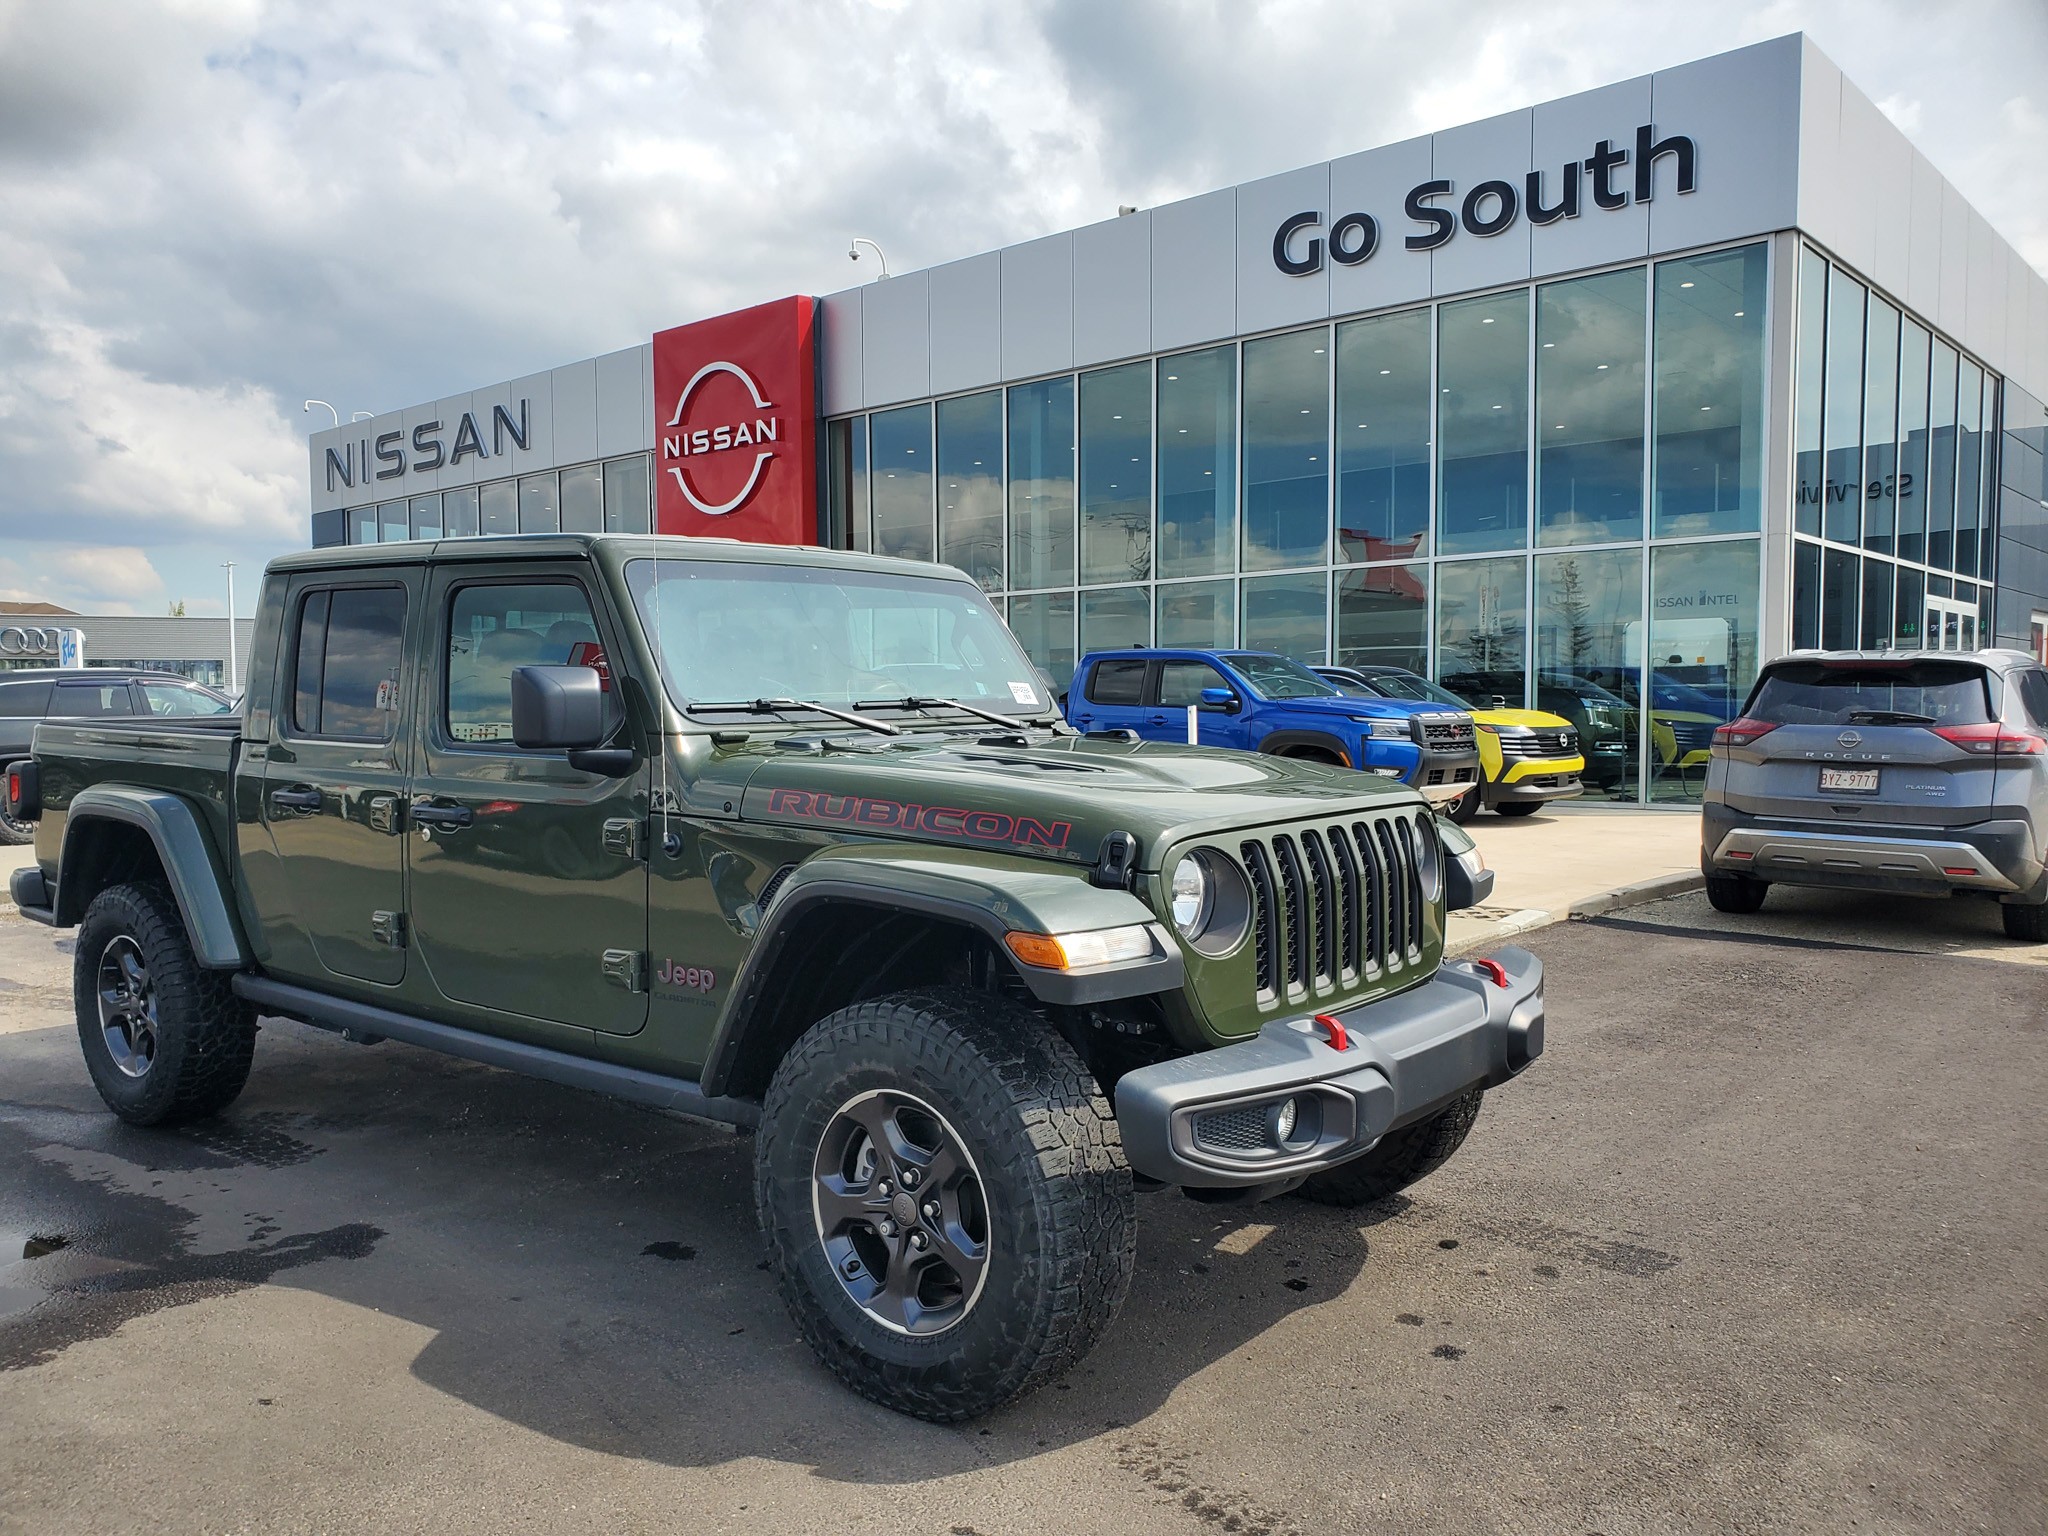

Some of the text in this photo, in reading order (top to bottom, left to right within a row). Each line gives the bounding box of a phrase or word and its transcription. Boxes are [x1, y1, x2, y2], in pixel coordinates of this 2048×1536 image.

[1272, 122, 1697, 277] Go South
[326, 398, 531, 492] NISSAN
[664, 416, 778, 460] NISSAN
[1654, 596, 1693, 608] ISSAN
[62, 635, 77, 666] flo
[1805, 751, 1891, 760] ROGUE
[1905, 784, 1947, 792] PLATINUM
[768, 788, 1072, 849] RUBICON
[657, 958, 716, 994] Jeep
